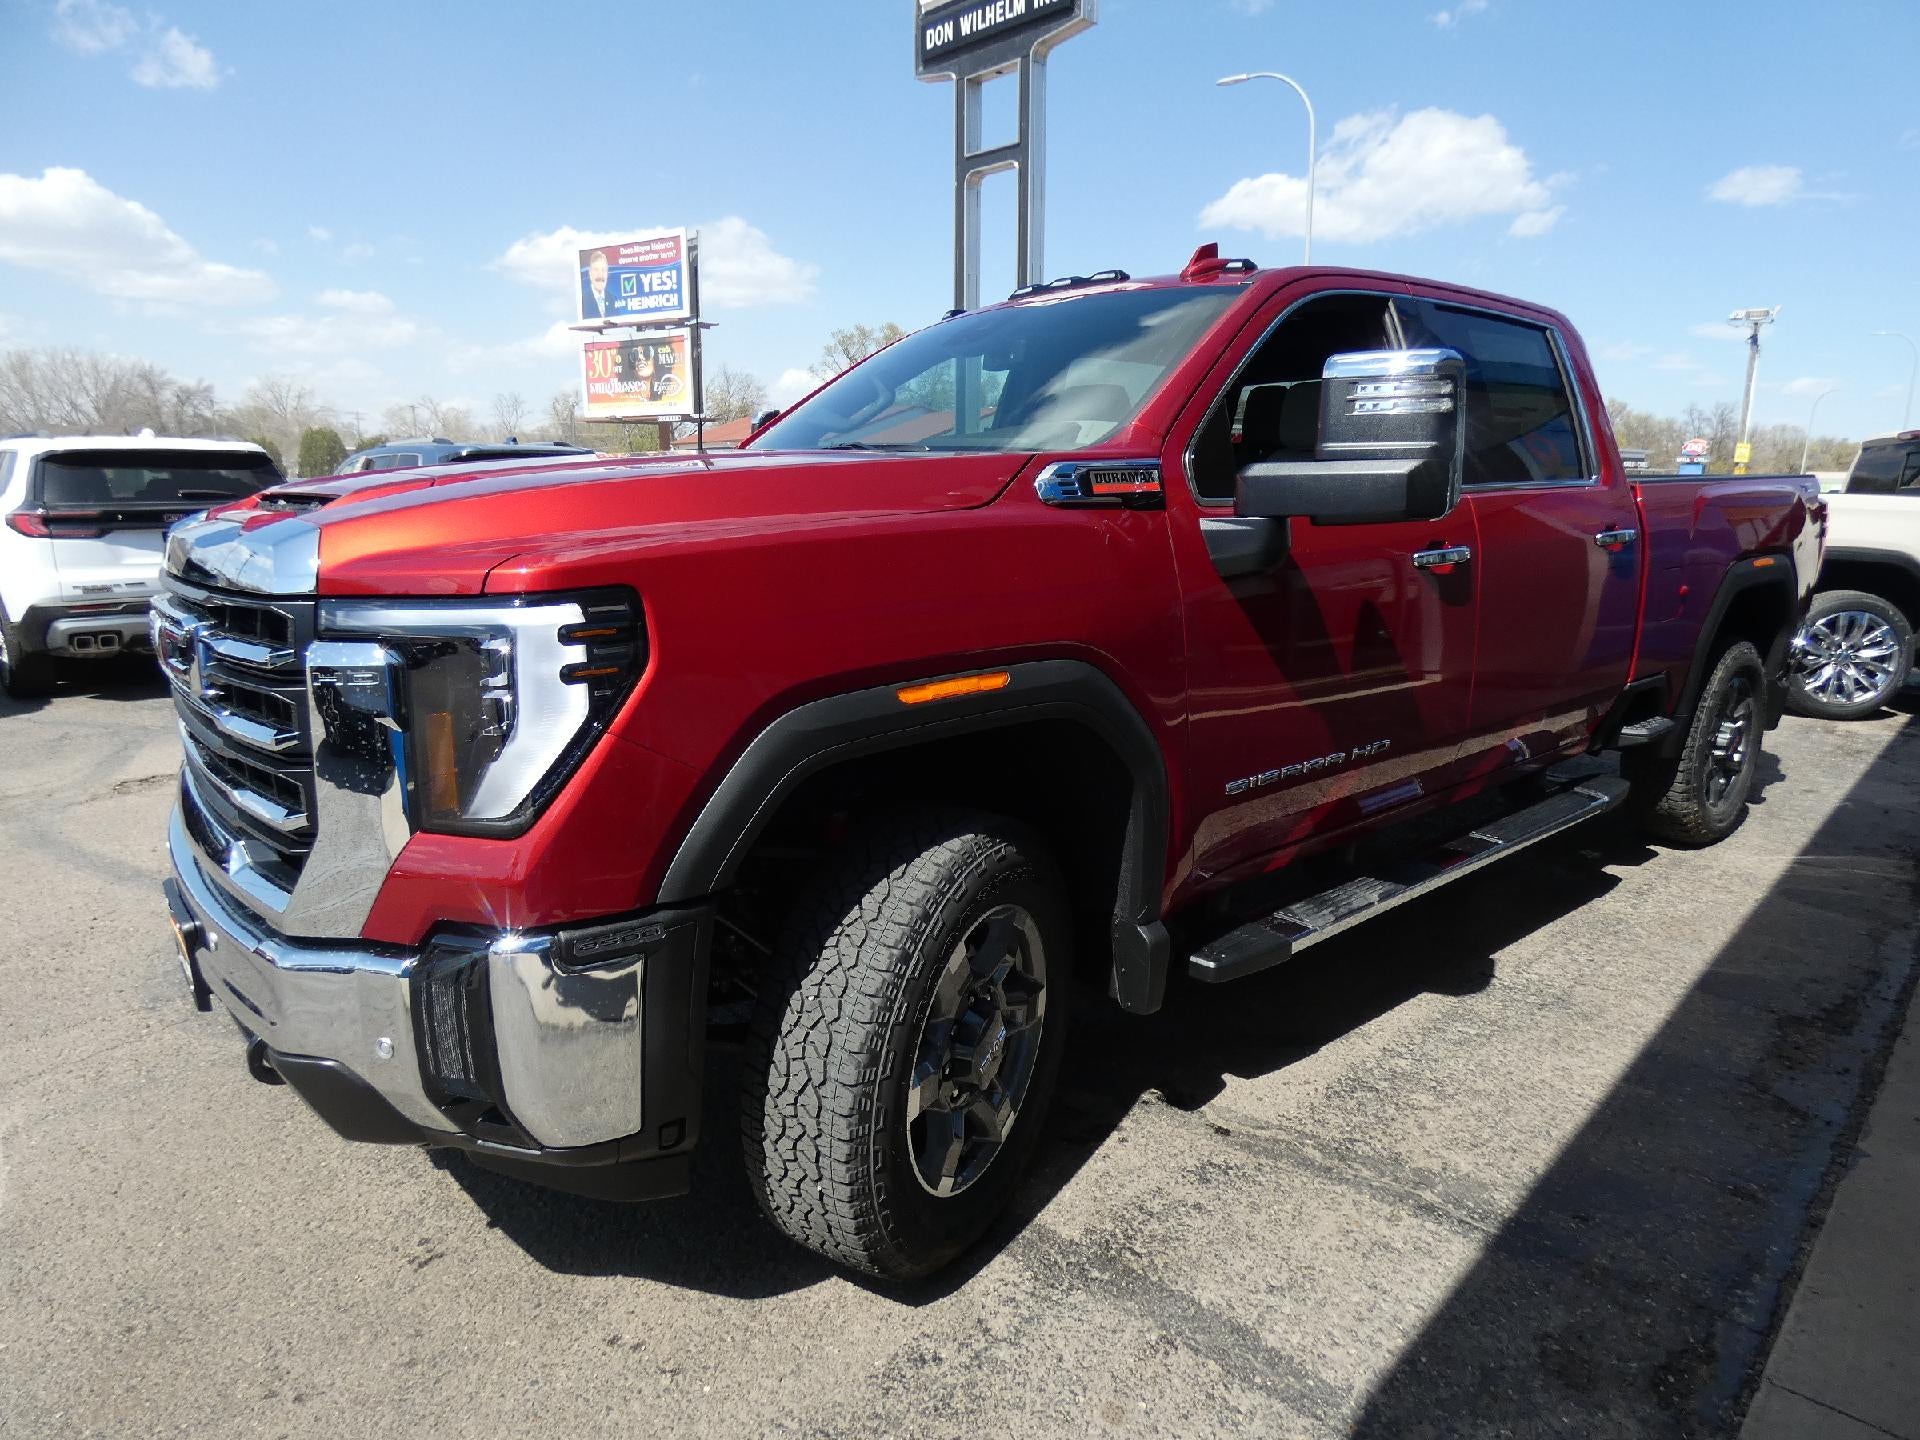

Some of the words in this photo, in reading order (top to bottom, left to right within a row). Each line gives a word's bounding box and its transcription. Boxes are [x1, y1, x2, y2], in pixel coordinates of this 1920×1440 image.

[926, 21, 954, 50] DON
[959, 0, 1026, 36] WILHELM
[640, 270, 678, 293] YES!
[627, 293, 679, 311] HEINRICH
[1094, 470, 1155, 484] DURAMAX
[1225, 752, 1346, 795] SIERRA
[1351, 739, 1391, 761] HD
